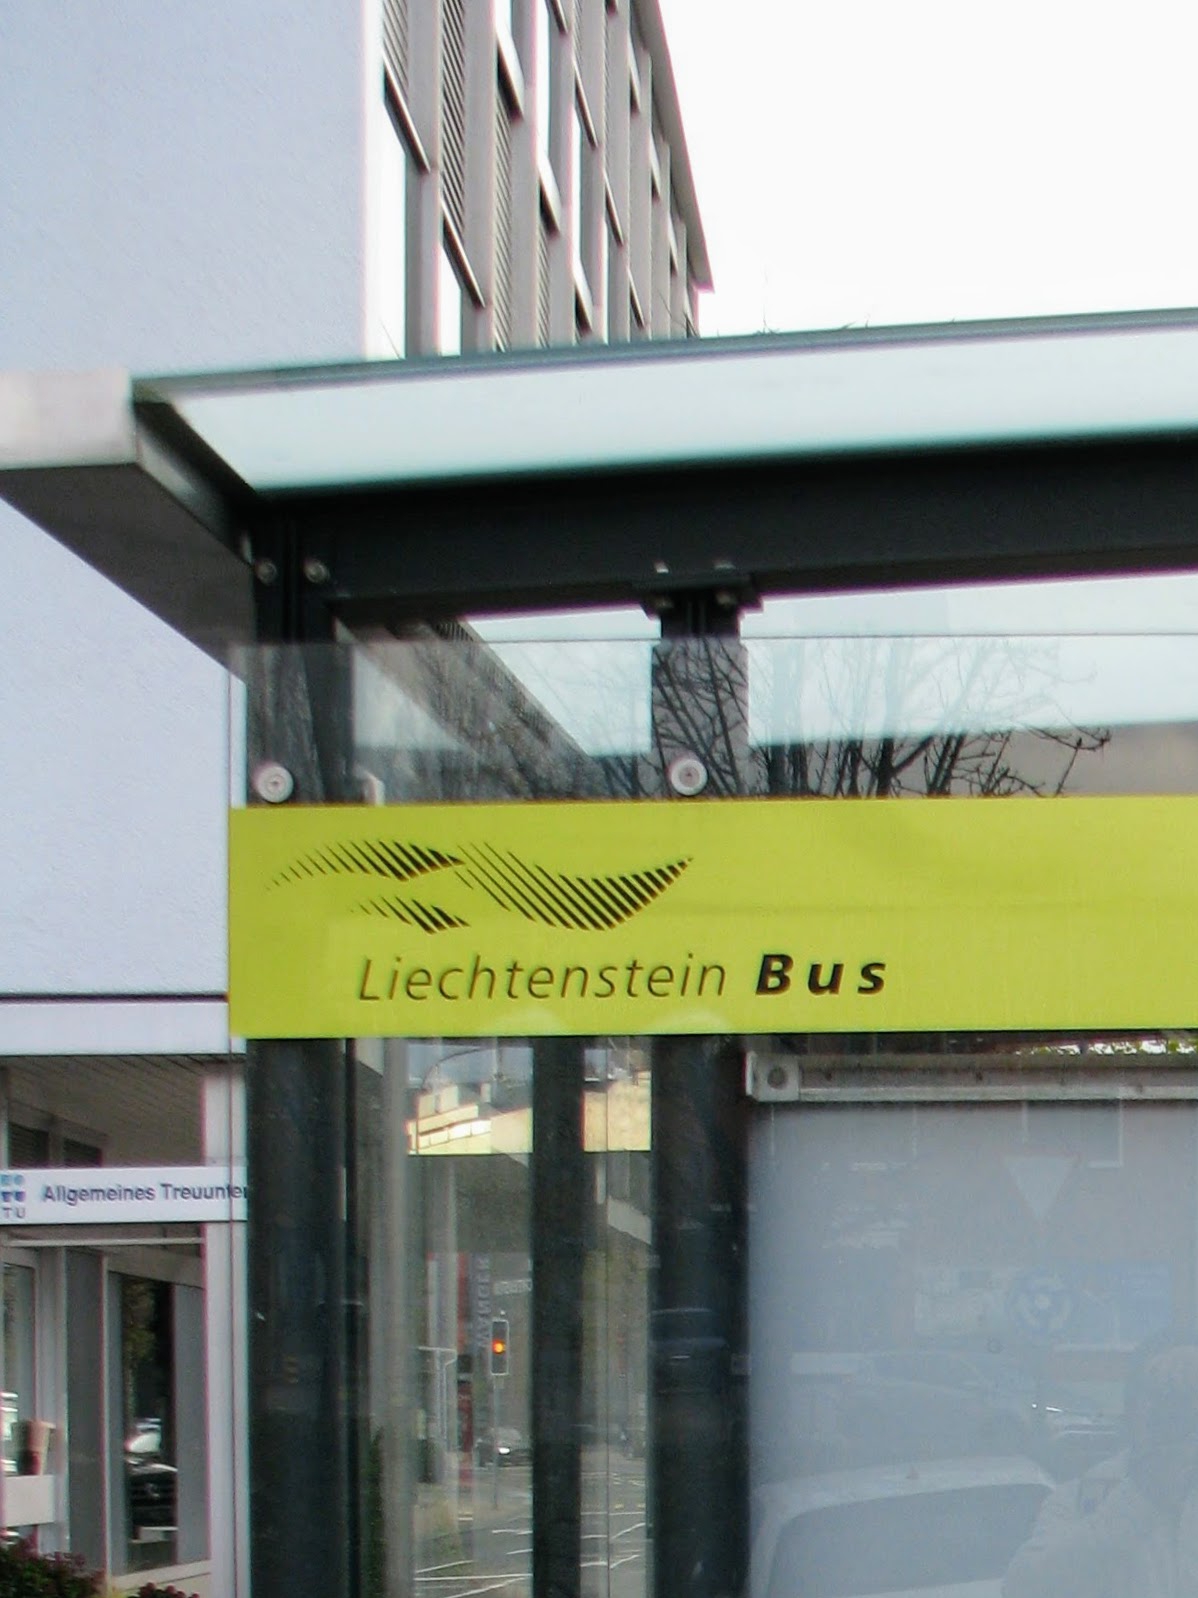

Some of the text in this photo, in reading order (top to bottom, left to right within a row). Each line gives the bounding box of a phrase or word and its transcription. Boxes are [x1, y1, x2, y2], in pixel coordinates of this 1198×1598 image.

[359, 952, 887, 1001] Liechtenstein Bus
[43, 1184, 155, 1206] Allgemeines
